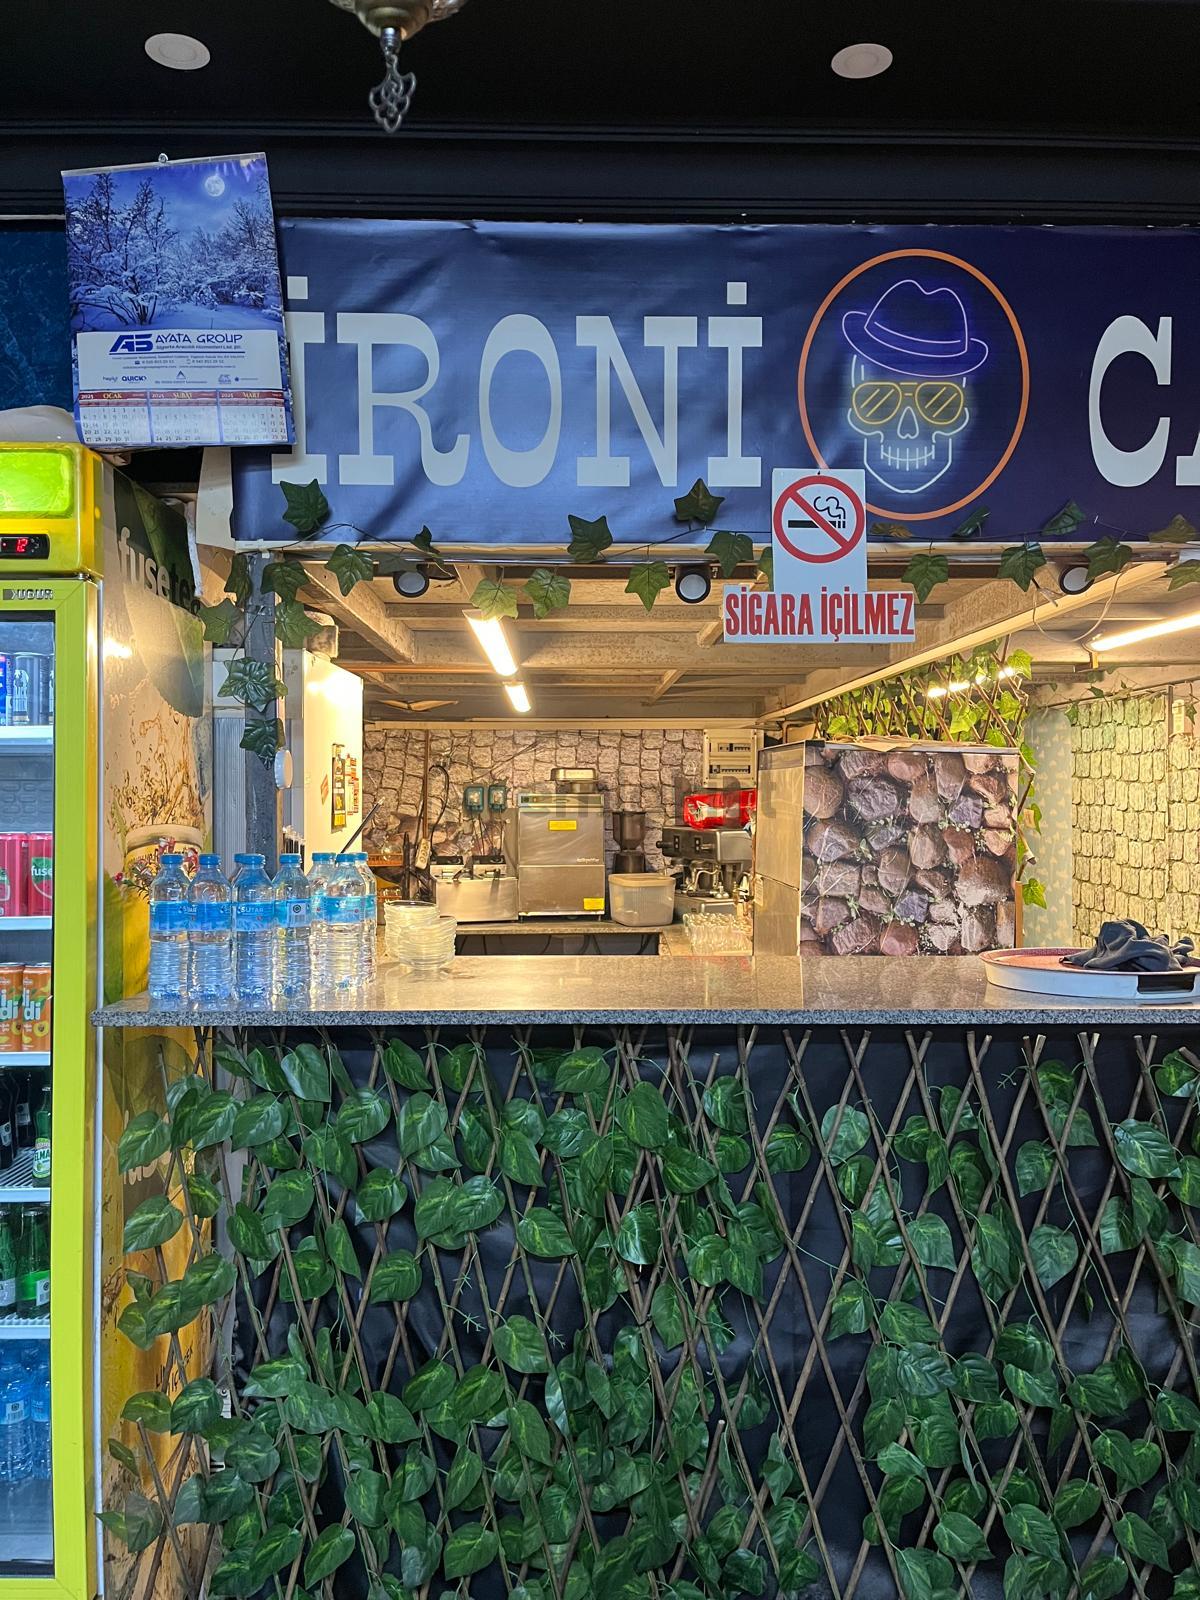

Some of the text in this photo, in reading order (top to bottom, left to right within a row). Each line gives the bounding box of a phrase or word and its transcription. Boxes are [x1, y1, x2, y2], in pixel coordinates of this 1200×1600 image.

[155, 333, 192, 344] AYATA
[196, 333, 243, 344] GROUP
[272, 276, 1200, 488] İRONİ C
[725, 586, 915, 642] SİGARA İÇİLMEZ
